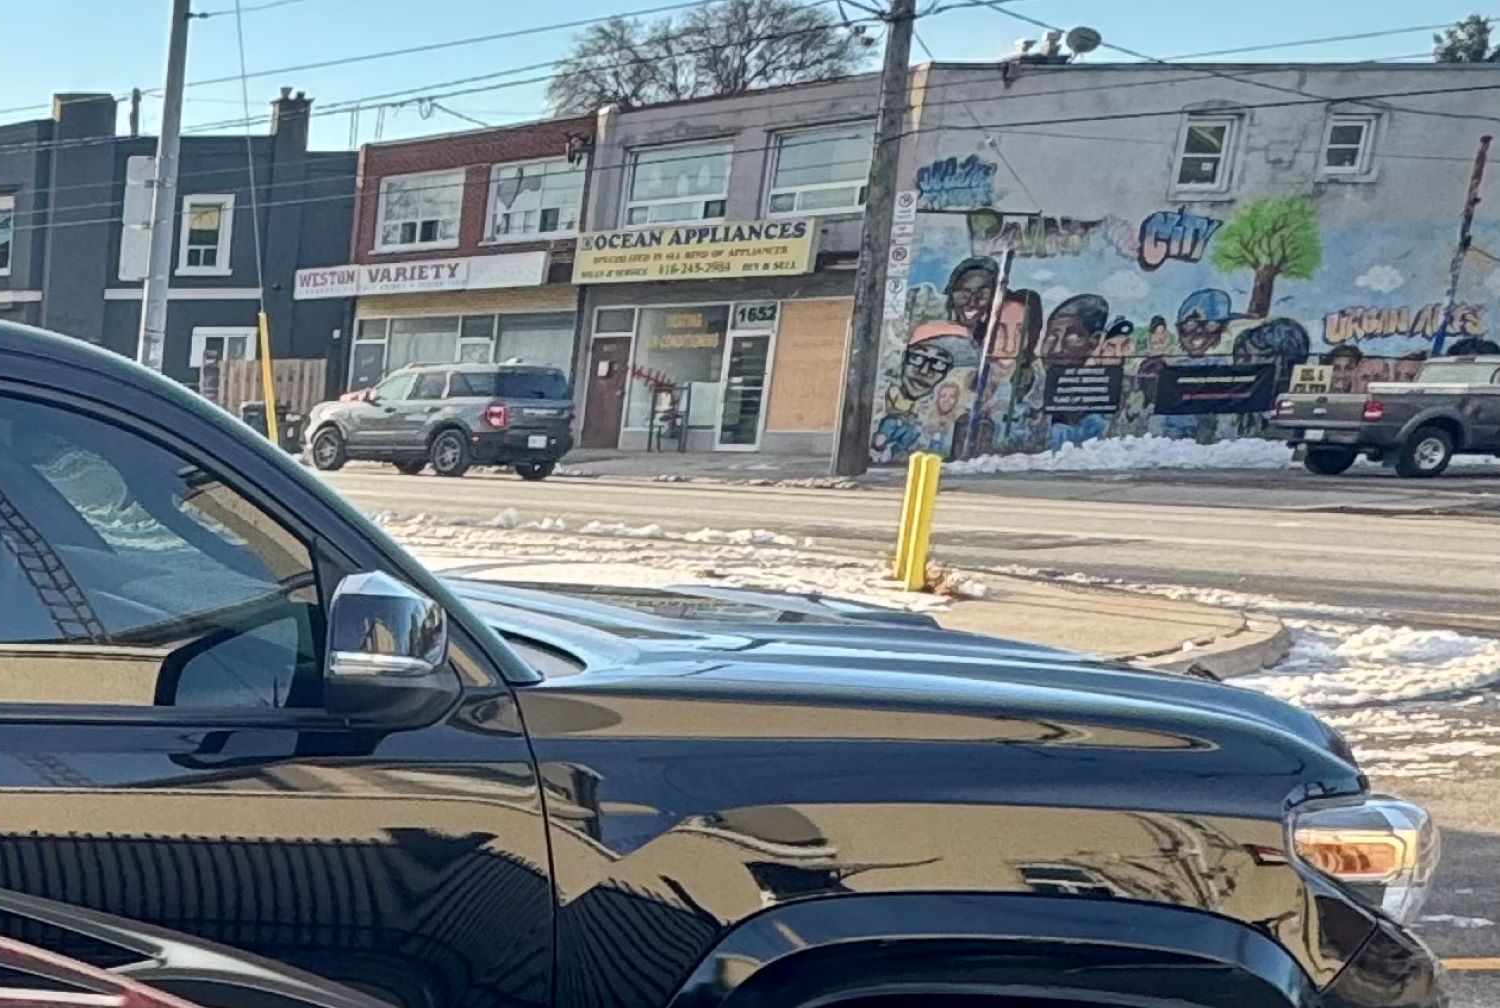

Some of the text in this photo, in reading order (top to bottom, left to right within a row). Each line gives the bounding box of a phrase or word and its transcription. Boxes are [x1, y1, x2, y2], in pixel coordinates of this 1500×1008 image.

[594, 221, 807, 250] OCEAN APPLIANCES
[368, 262, 461, 284] VARIETY
